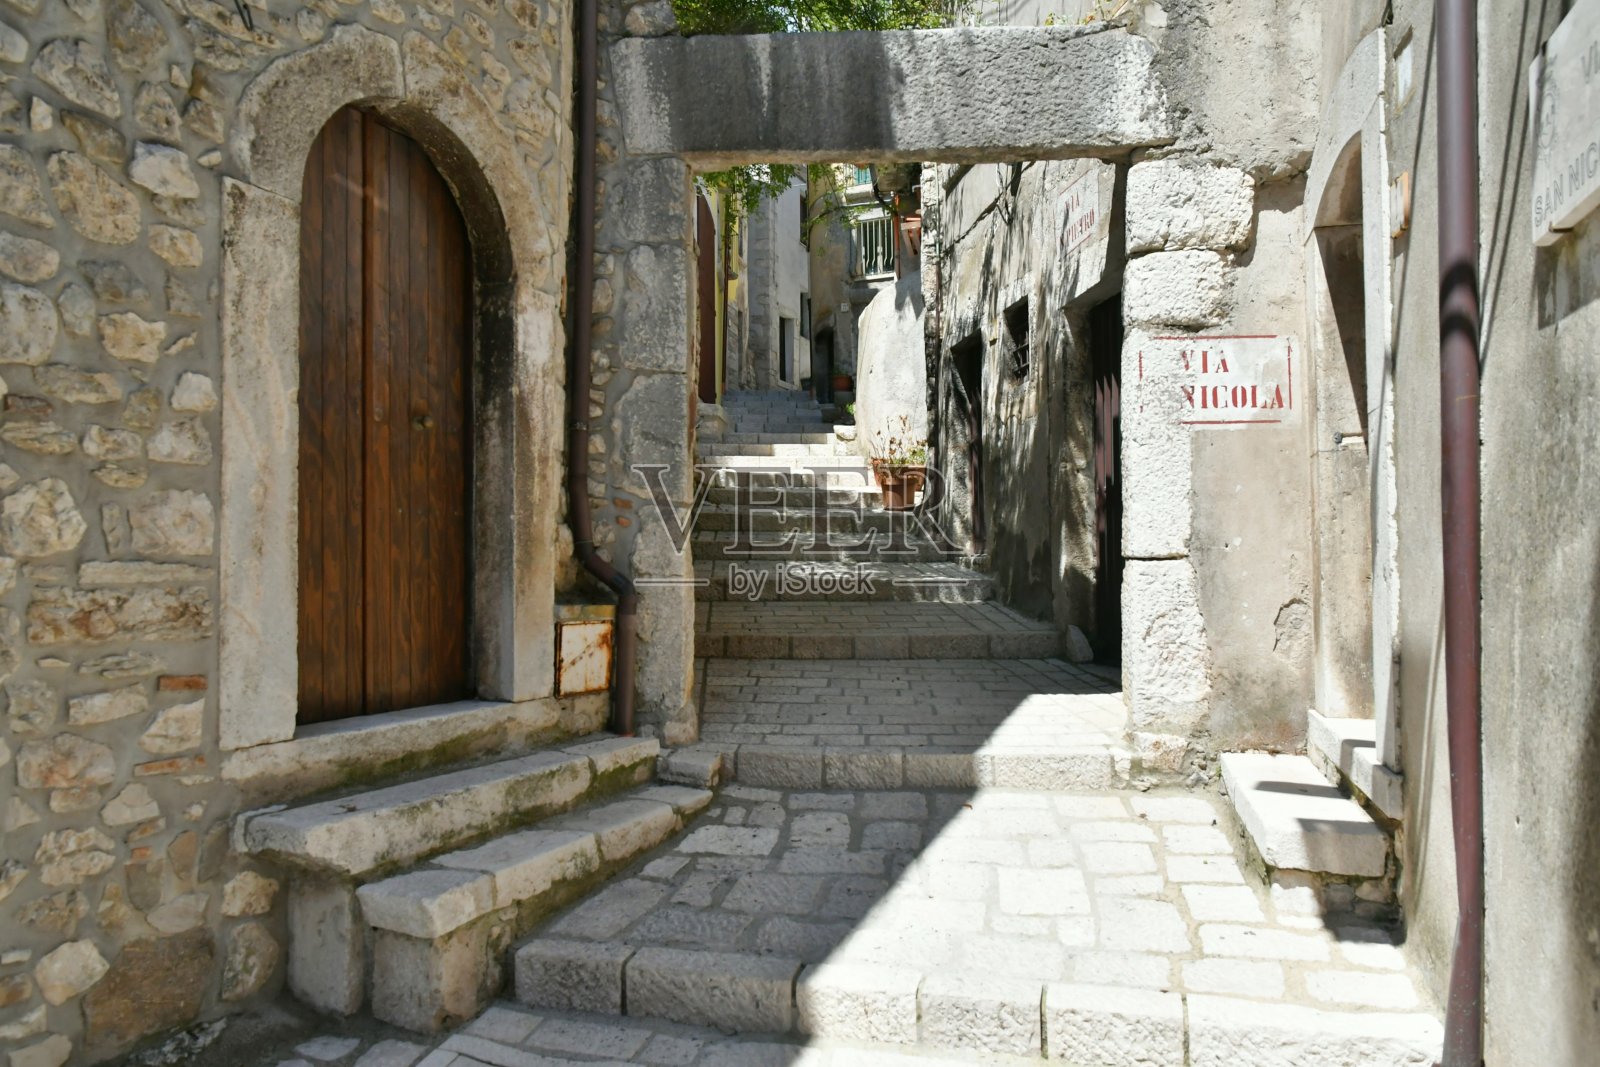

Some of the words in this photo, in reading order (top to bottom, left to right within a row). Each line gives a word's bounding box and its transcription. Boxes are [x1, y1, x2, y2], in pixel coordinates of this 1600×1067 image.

[1581, 40, 1600, 84] VI
[1535, 173, 1564, 228] SAN
[1568, 142, 1600, 197] NIC
[1180, 349, 1229, 374] VIA
[1180, 384, 1285, 409] NICOLA
